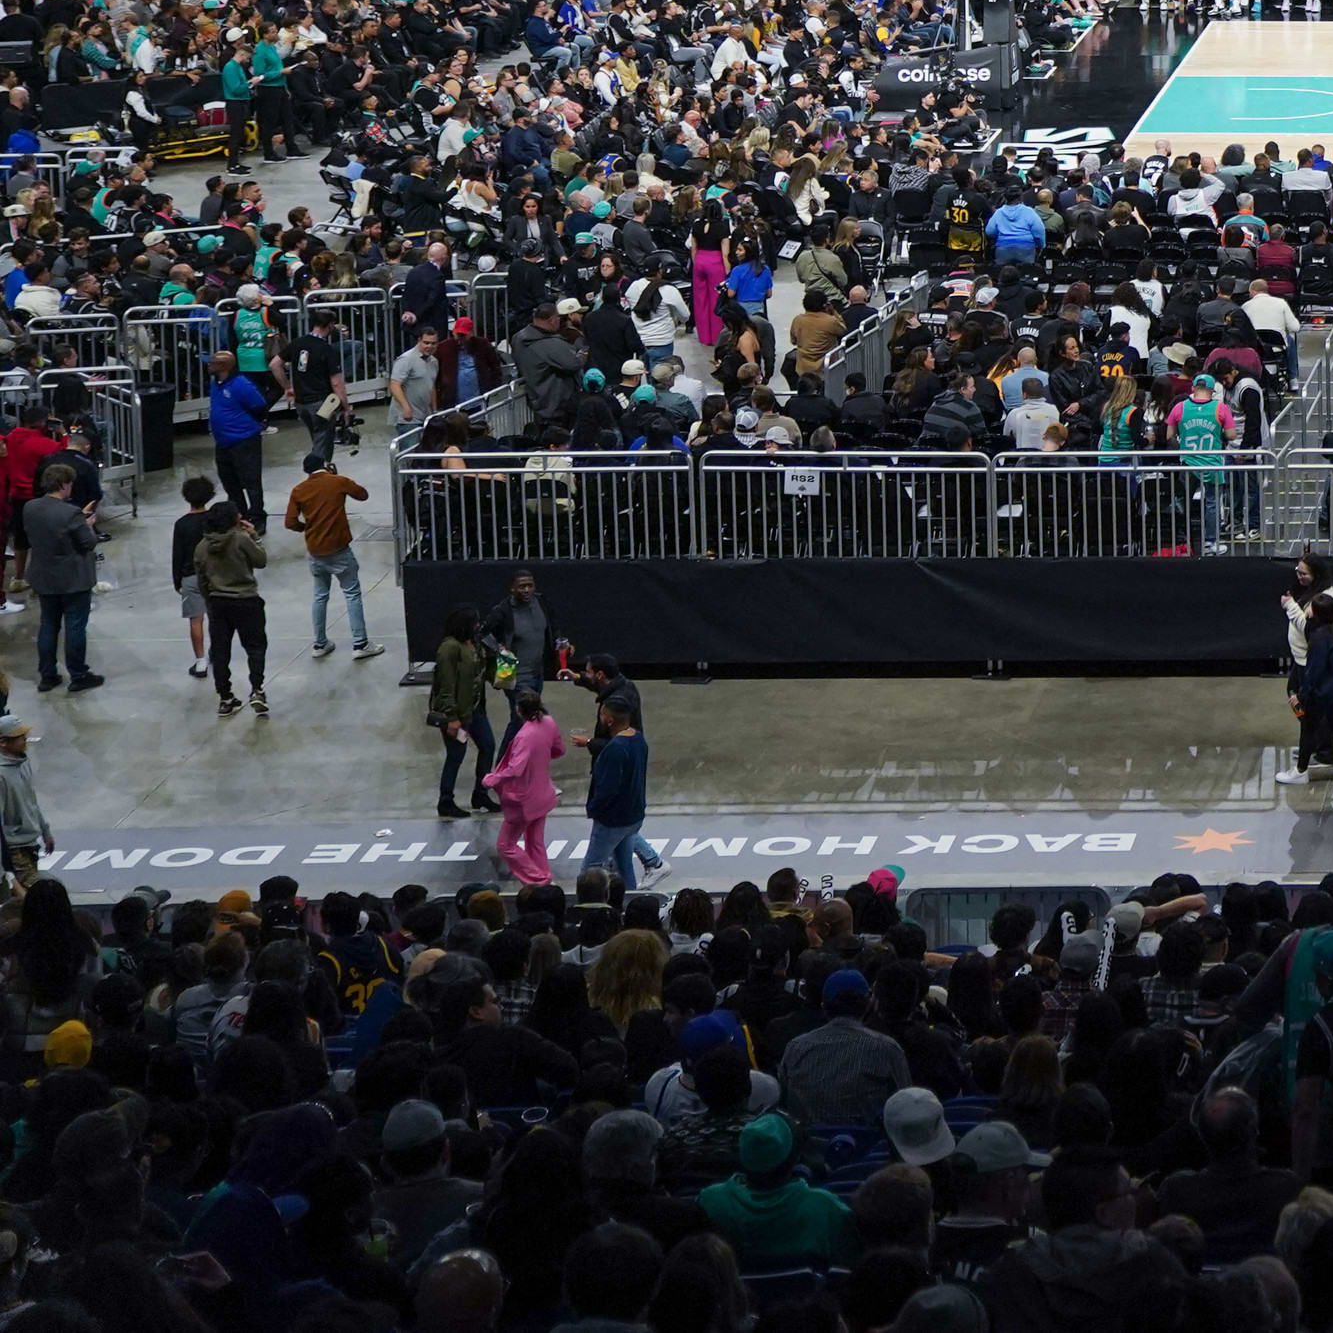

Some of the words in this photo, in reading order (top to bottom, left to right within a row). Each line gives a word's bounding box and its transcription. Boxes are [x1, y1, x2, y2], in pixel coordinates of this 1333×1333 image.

[898, 64, 991, 83] coinse
[951, 207, 969, 224] 30
[1184, 433, 1214, 451] 50
[790, 474, 816, 483] RS2
[301, 841, 481, 865] THE
[896, 832, 1137, 856] BACK
